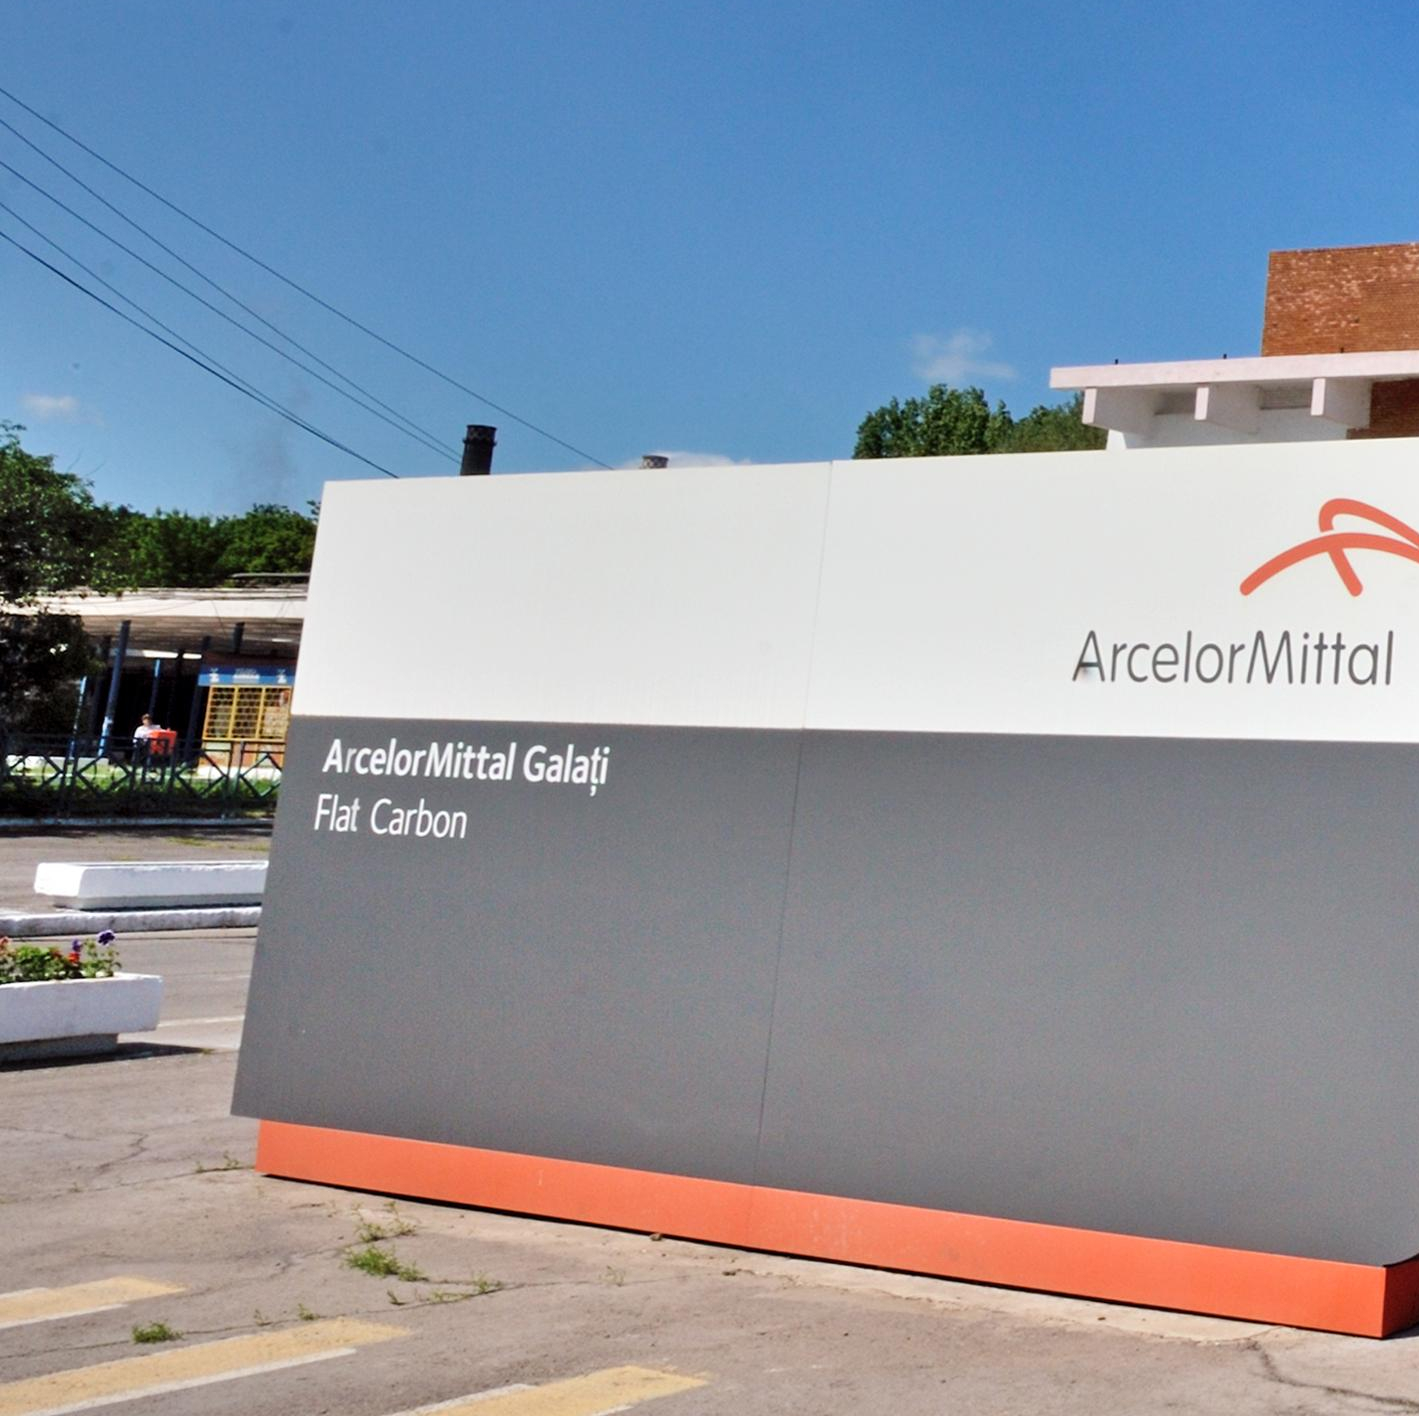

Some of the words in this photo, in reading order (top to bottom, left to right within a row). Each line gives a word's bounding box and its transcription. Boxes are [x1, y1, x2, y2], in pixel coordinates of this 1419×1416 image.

[1072, 629, 1394, 686] ArcelorMittal
[322, 737, 517, 781] ArcelorMittal
[523, 742, 611, 797] Galați
[314, 793, 360, 832] Flat
[370, 797, 468, 839] Carbon
